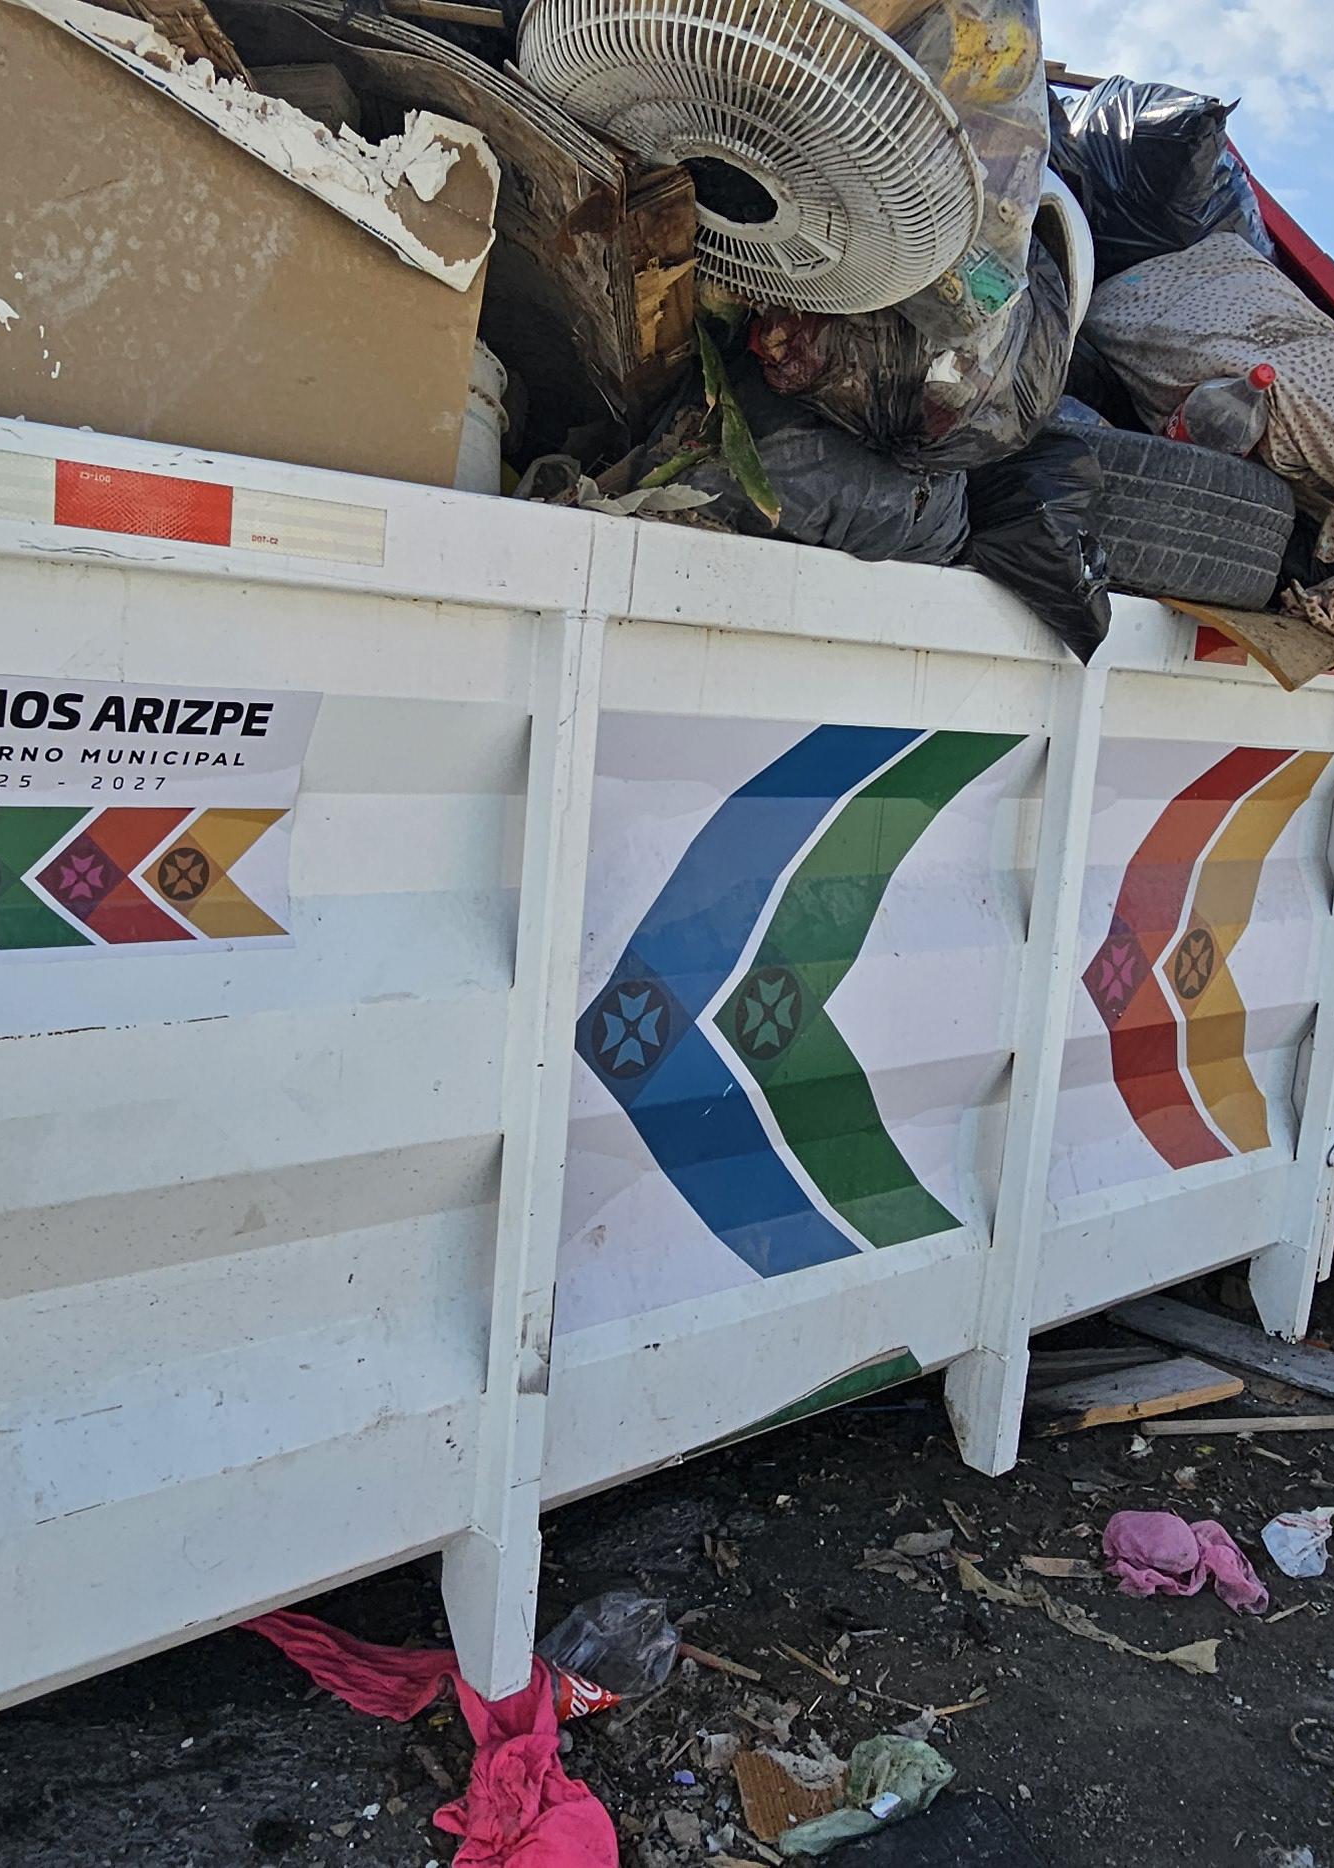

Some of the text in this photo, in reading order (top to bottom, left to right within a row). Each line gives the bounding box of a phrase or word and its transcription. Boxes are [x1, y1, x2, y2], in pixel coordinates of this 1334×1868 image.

[251, 534, 279, 545] DOT-C2
[89, 695, 274, 737] ARIZPE
[80, 748, 246, 766] MUNICIPAL
[90, 776, 167, 791] 2027
